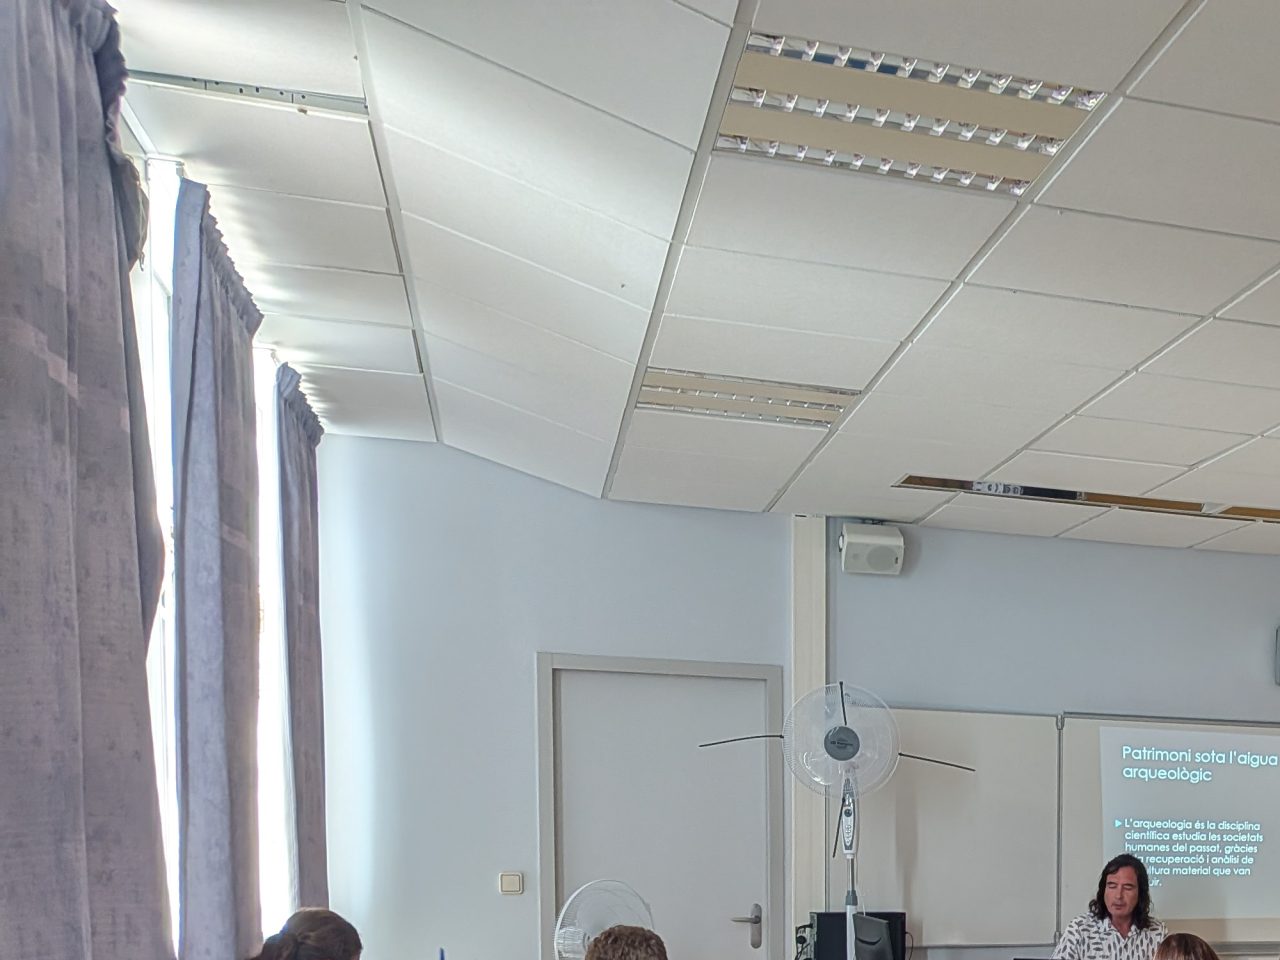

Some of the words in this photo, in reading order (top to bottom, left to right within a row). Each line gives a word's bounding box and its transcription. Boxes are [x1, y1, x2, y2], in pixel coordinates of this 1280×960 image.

[1122, 746, 1191, 763] Patrimoni
[1195, 750, 1226, 764] sota
[1122, 766, 1212, 783] arqueològic
[1195, 821, 1204, 830] és
[1207, 820, 1216, 830] la
[1218, 821, 1260, 831] disciplina
[1172, 832, 1206, 841] estudia
[1209, 833, 1221, 841] les
[1223, 833, 1263, 842] societats
[1125, 843, 1169, 852] humanes
[1172, 843, 1187, 852] del
[1224, 844, 1257, 854] gràcies
[1146, 854, 1204, 865] recuperació
[1211, 855, 1239, 864] anàlisi
[1242, 855, 1253, 864] de
[1173, 866, 1210, 875] material
[1213, 868, 1230, 876] que
